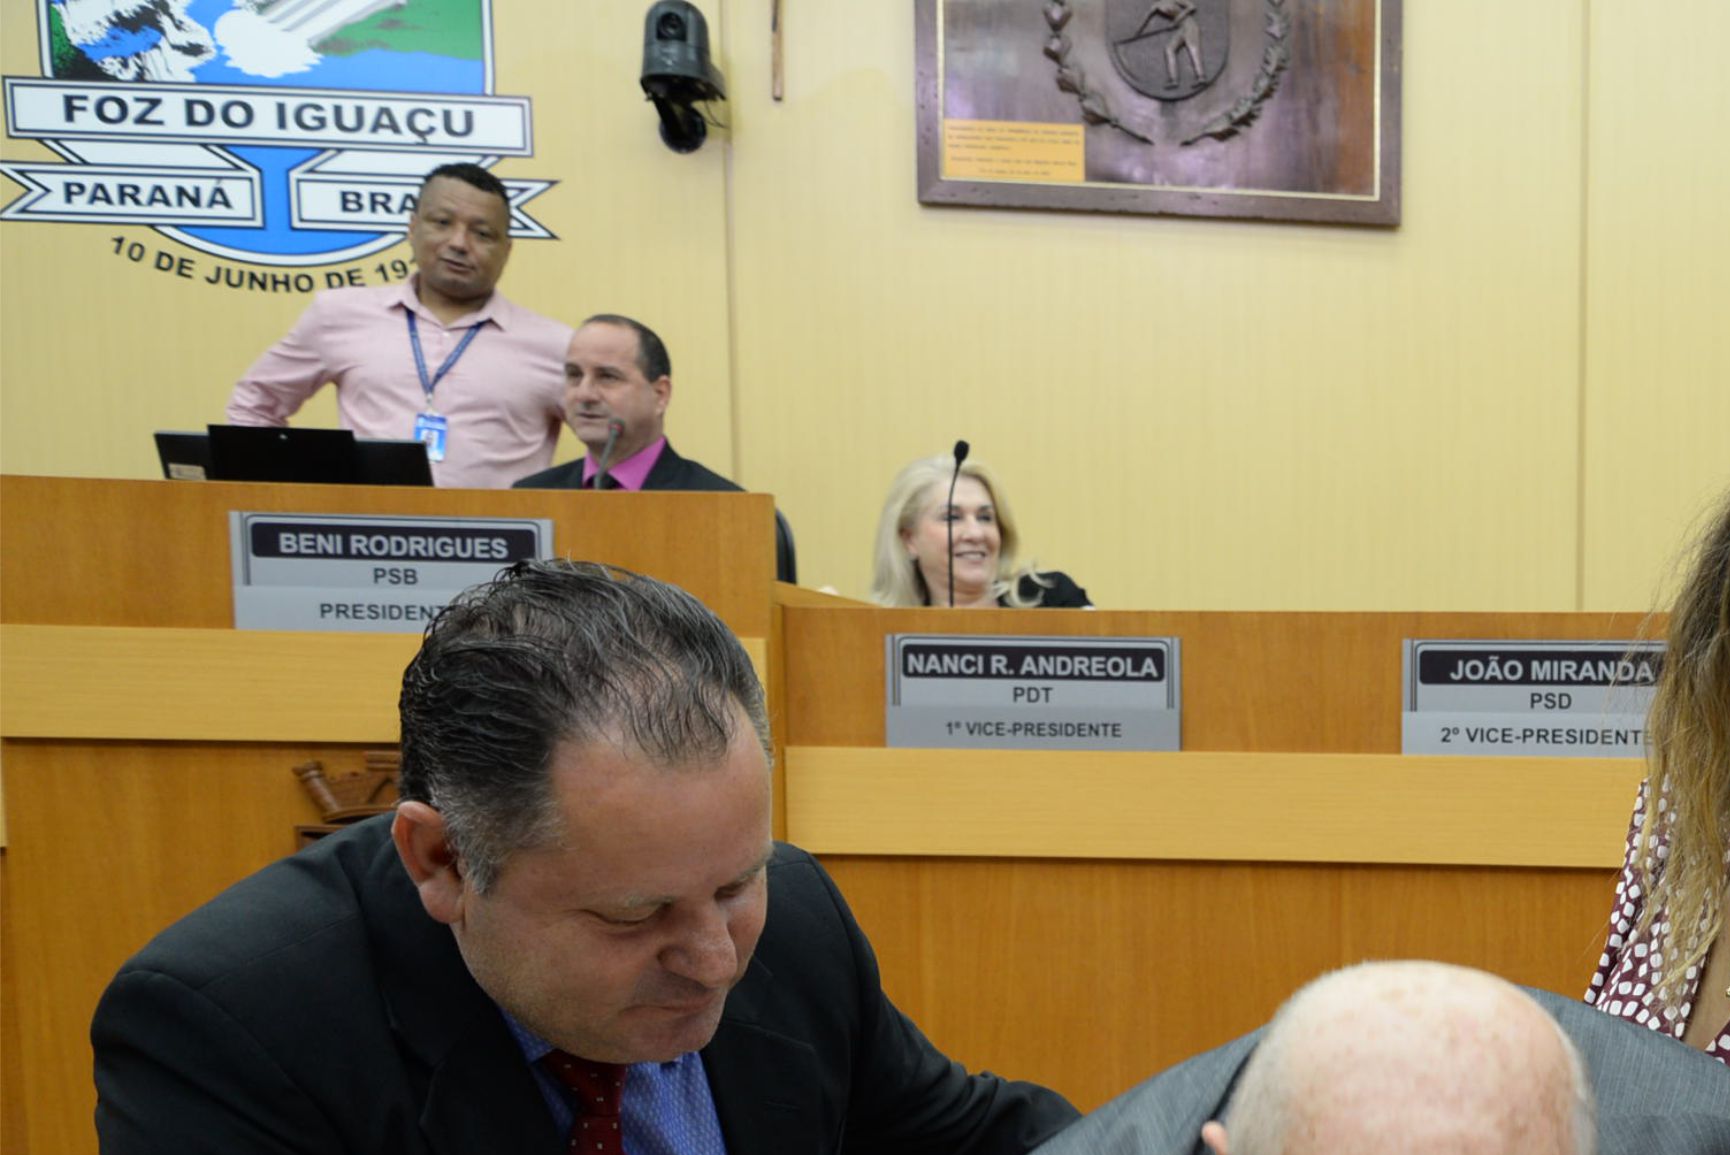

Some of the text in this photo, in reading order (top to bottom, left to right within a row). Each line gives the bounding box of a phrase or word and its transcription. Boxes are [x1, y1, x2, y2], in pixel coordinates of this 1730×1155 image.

[63, 94, 475, 145] FOZ DO IGUAÇU
[63, 178, 233, 210] PARANÁ
[340, 190, 416, 215] BRA
[111, 235, 417, 293] 10 DE JUNHO DE 19
[279, 532, 509, 559] BENI RODRIGUES
[373, 567, 418, 585] PSB
[320, 603, 447, 621] PRESIDENT
[907, 653, 1158, 677] NANCI R. ANDREOLA
[1450, 655, 1655, 682] JOÃO MIRANDA
[1013, 687, 1053, 703] PDT
[1530, 692, 1572, 709] PSD
[966, 721, 1122, 738] VICE-PRESIDENTE
